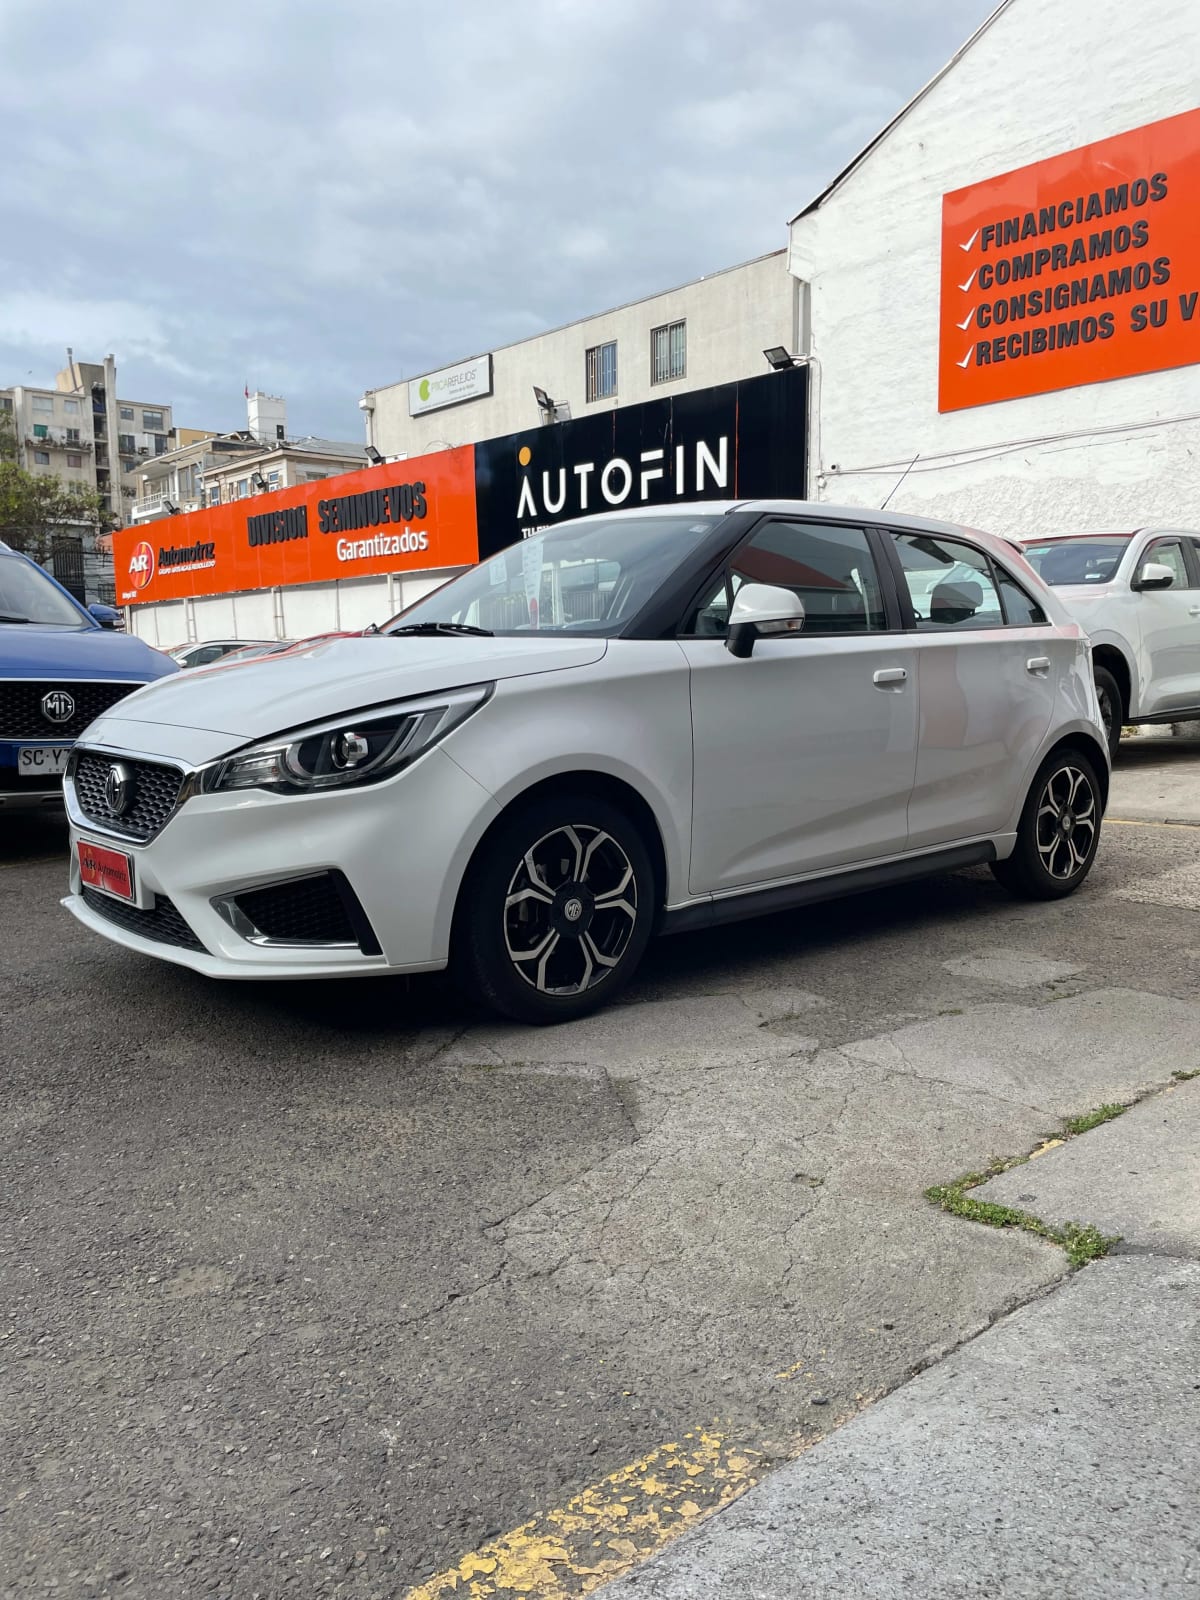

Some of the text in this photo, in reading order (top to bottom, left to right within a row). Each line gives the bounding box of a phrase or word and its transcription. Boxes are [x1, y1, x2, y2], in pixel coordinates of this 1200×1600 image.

[980, 172, 1168, 251] FINANCIAMOS
[978, 219, 1149, 290] COMPRAMOS
[976, 256, 1171, 329] CONSIGNAMOS
[975, 291, 1200, 366] RECIBIMOS SU V
[517, 436, 728, 519] AUTOFIN
[247, 481, 427, 547] DIVISION SEMINUEVOS
[336, 526, 428, 561] Garantizados
[158, 541, 215, 568] Automotriz
[45, 693, 73, 720] MG
